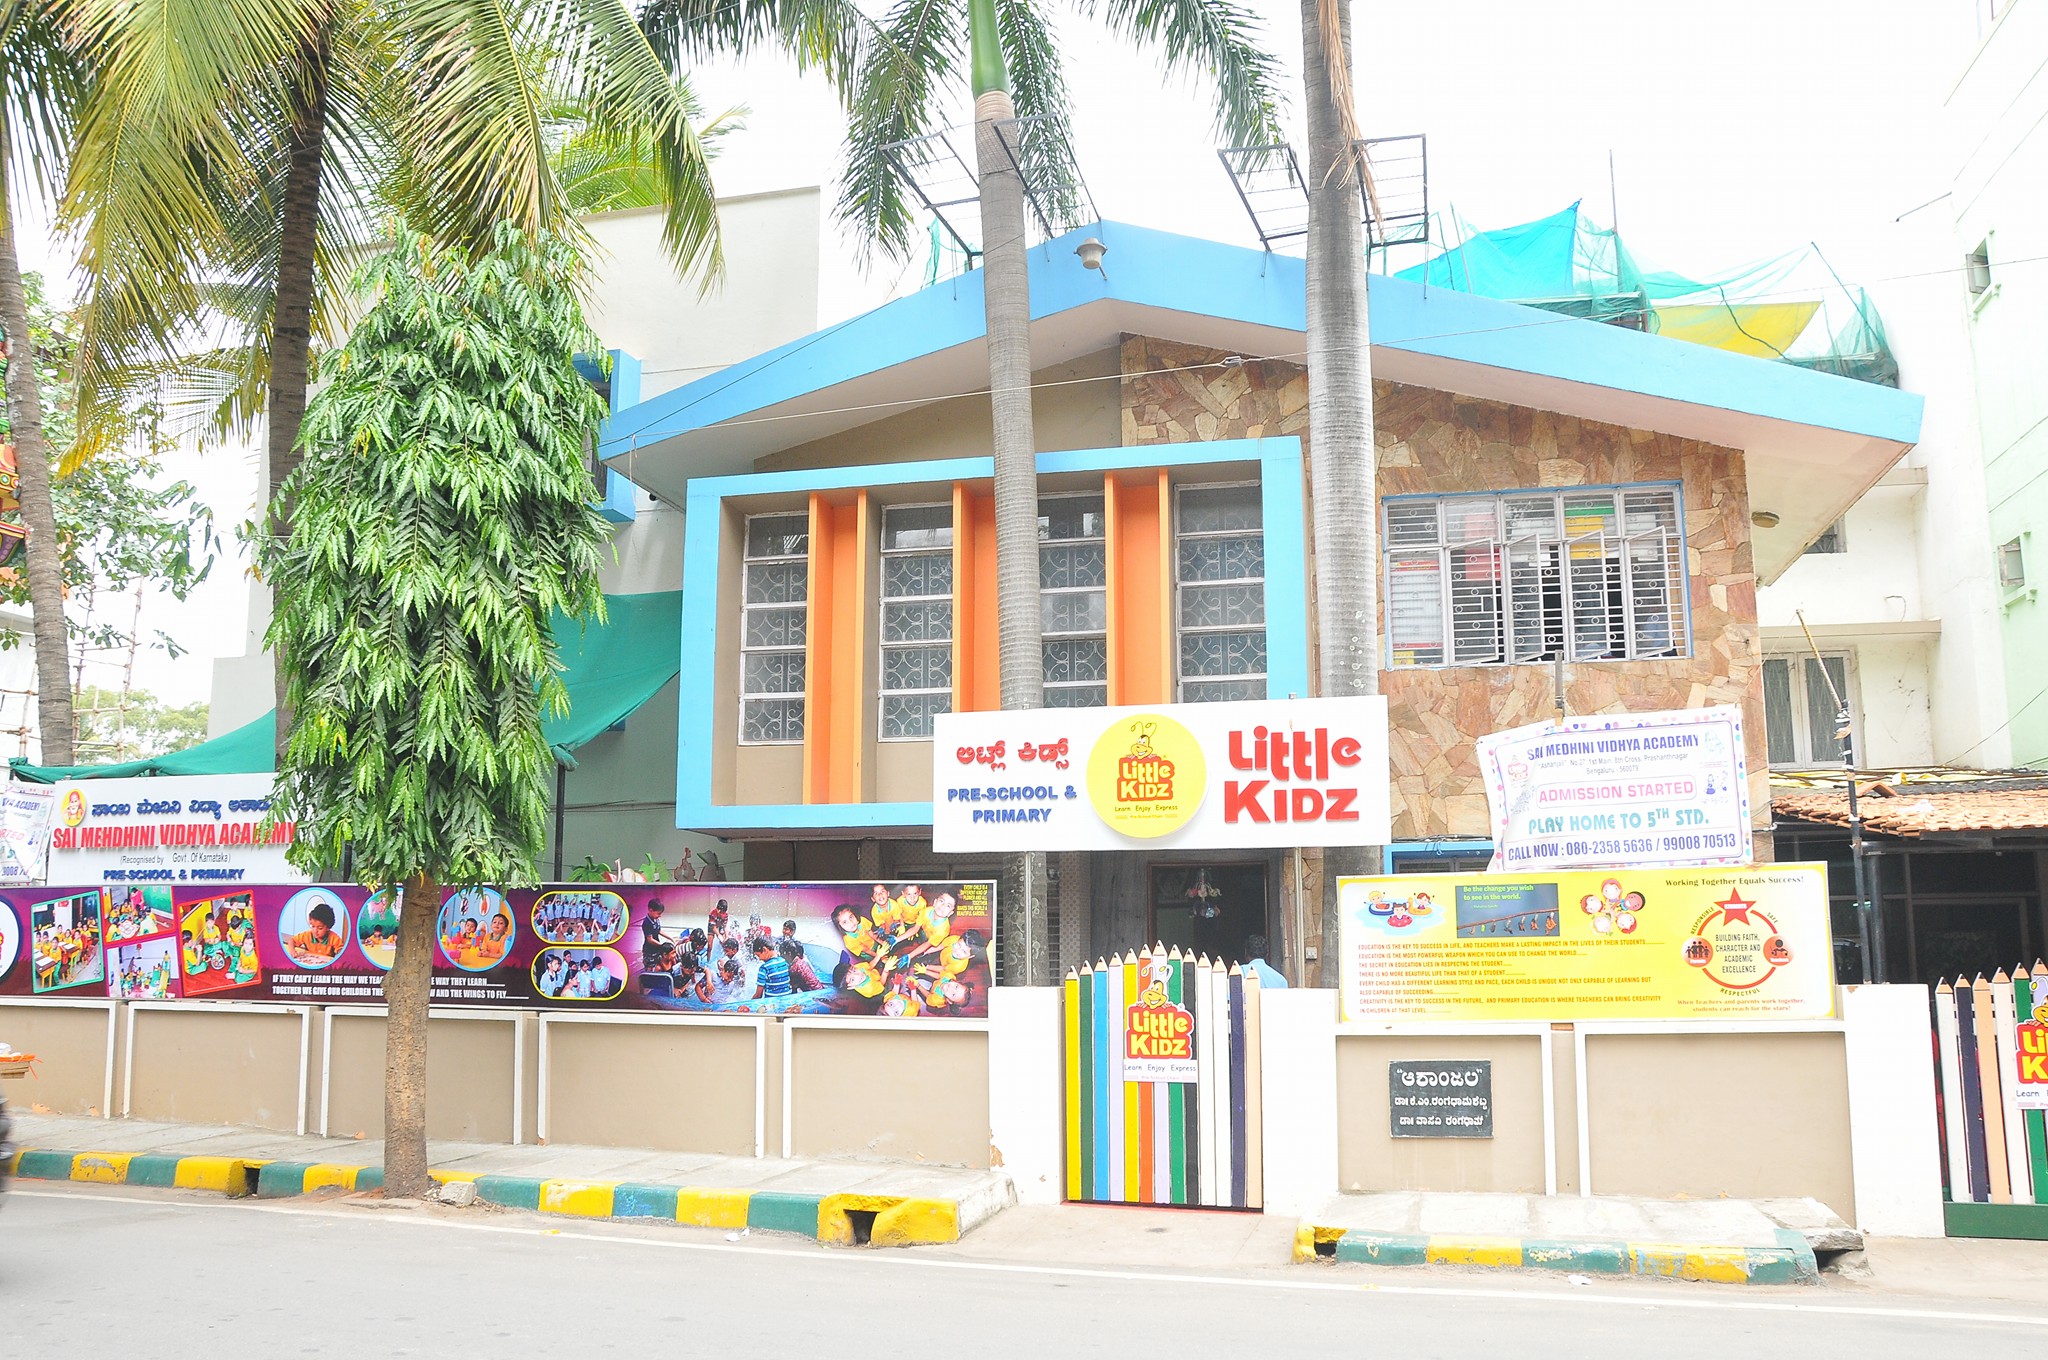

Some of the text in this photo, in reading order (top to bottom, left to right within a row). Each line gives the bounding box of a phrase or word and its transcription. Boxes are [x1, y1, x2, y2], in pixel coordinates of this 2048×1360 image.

[1229, 726, 1361, 781] Little
[1527, 734, 1699, 760] SAI MEDHINI VIDHYA ACADEMY
[1122, 760, 1170, 783] Little
[948, 785, 1077, 801] PRE-SCHOOL &
[1539, 782, 1693, 803] ADMISSION STARTED
[972, 808, 1052, 822] PRIMARY
[1529, 816, 1564, 834] PLAY
[1570, 814, 1615, 831] HOME
[1620, 812, 1641, 828] TO
[1676, 808, 1710, 826] STD.
[54, 827, 76, 848] SAI
[81, 826, 156, 848] MEHDHINI
[160, 824, 216, 846] VIDHYA
[1508, 845, 1532, 860] CALL
[1534, 843, 1558, 858] NOW
[1566, 840, 1620, 855] 080-2358
[1624, 838, 1652, 853] 5636
[1664, 836, 1700, 851] 99008
[1703, 834, 1736, 848] 70513
[156, 856, 164, 866] by
[191, 853, 198, 862] Of
[104, 868, 245, 880] PRE-SCHOOL & PRIMARY
[1701, 878, 1736, 886] Together
[1739, 877, 1766, 885] Equals
[1768, 876, 1804, 884] Success!
[1766, 912, 1778, 924] SAFE
[1742, 933, 1760, 941] FAITH,
[1716, 944, 1761, 952] CHARACTER AND
[1722, 965, 1756, 973] EXCELLENCE
[279, 975, 294, 983] THEY
[295, 975, 312, 983] CAN'T
[312, 975, 330, 983] LEARN
[331, 976, 343, 984] THE
[343, 976, 357, 984] WAY
[358, 976, 369, 984] WE
[272, 986, 301, 994] TOGETHER
[302, 986, 312, 994] WE
[313, 987, 327, 995] GIVE
[327, 987, 340, 995] OUR
[341, 987, 371, 996] CHILDREN
[463, 990, 486, 998] WINGS
[486, 990, 496, 998] TO
[1720, 988, 1760, 996] RESPECTFUL
[1132, 1010, 1188, 1038] Little
[1170, 1064, 1196, 1072] Express
